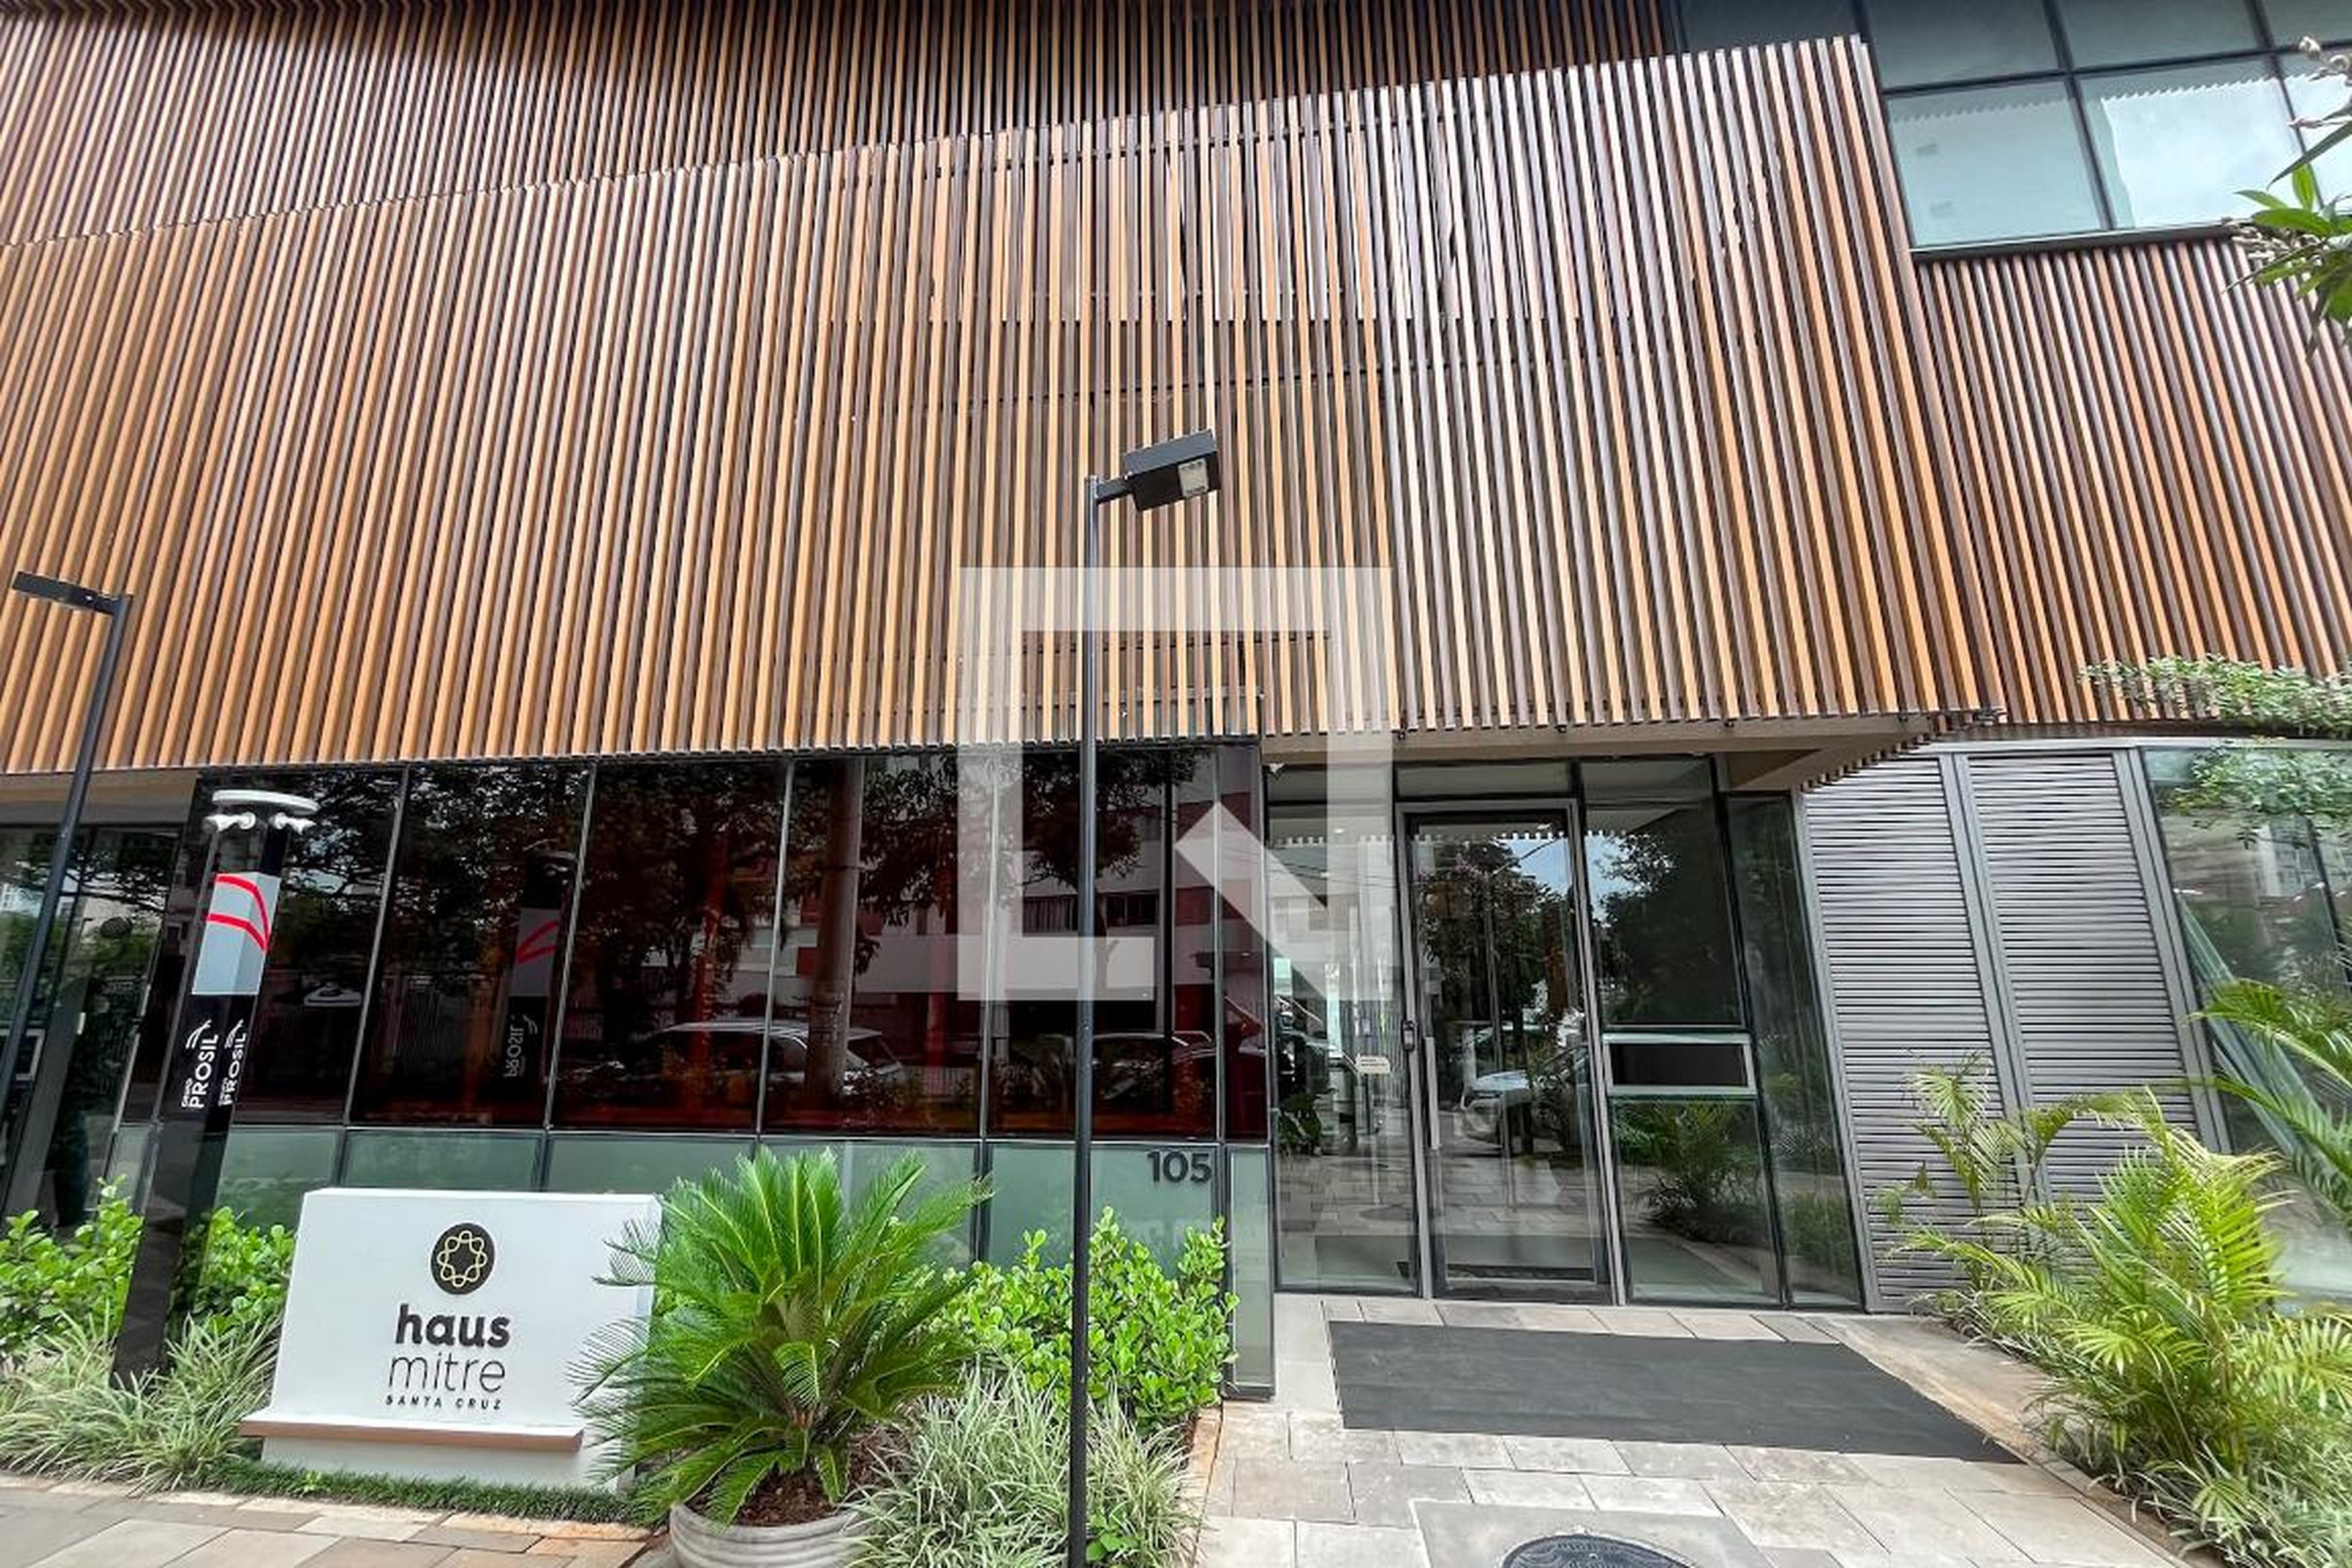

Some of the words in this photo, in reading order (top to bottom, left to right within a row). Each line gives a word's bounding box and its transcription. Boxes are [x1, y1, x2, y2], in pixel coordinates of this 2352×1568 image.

[188, 1035, 219, 1109] PROSIL
[220, 1033, 246, 1106] PROSIL
[1147, 1152, 1212, 1183] 105
[396, 1303, 511, 1348] haus
[388, 1352, 505, 1393] mitre
[386, 1395, 442, 1408] SANTA
[455, 1398, 501, 1409] CRUZ
